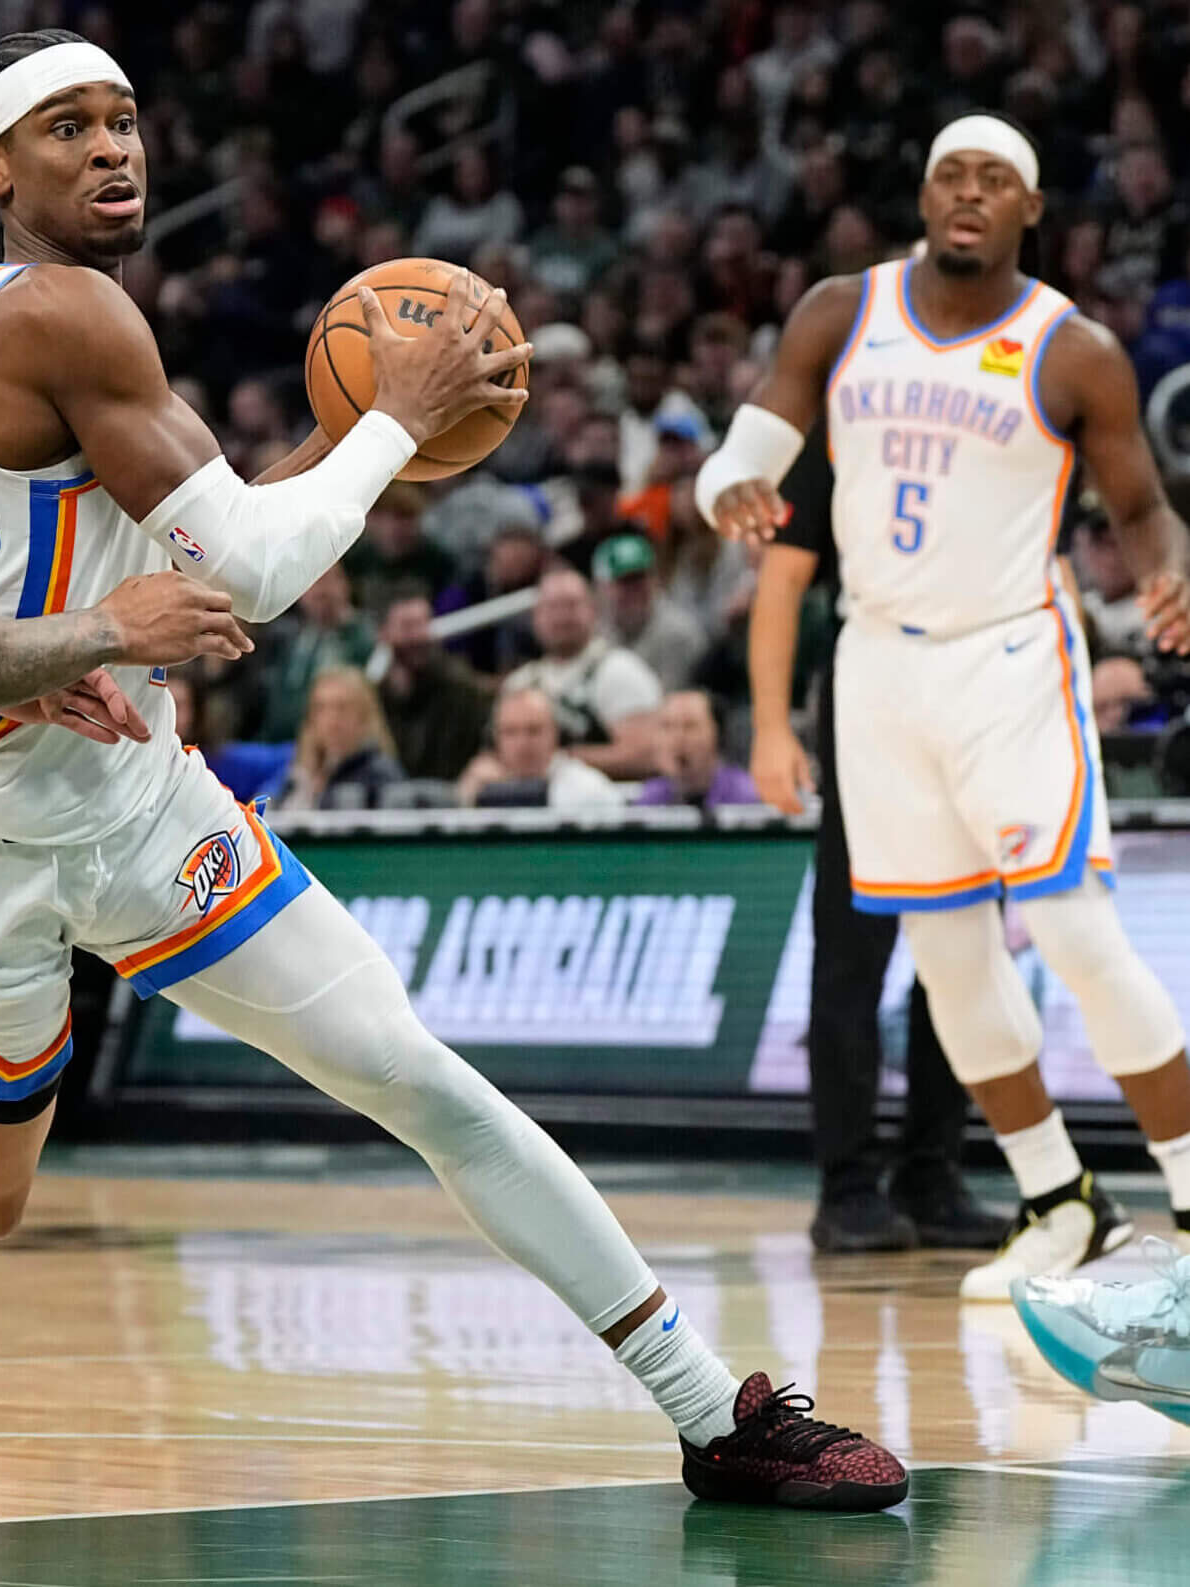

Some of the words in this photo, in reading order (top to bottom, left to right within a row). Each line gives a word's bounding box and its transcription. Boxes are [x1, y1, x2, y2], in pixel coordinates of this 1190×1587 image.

[838, 379, 1024, 447] OKLAHOMA
[882, 427, 957, 476] CITY
[892, 479, 929, 555] 5
[193, 842, 225, 909] OKC
